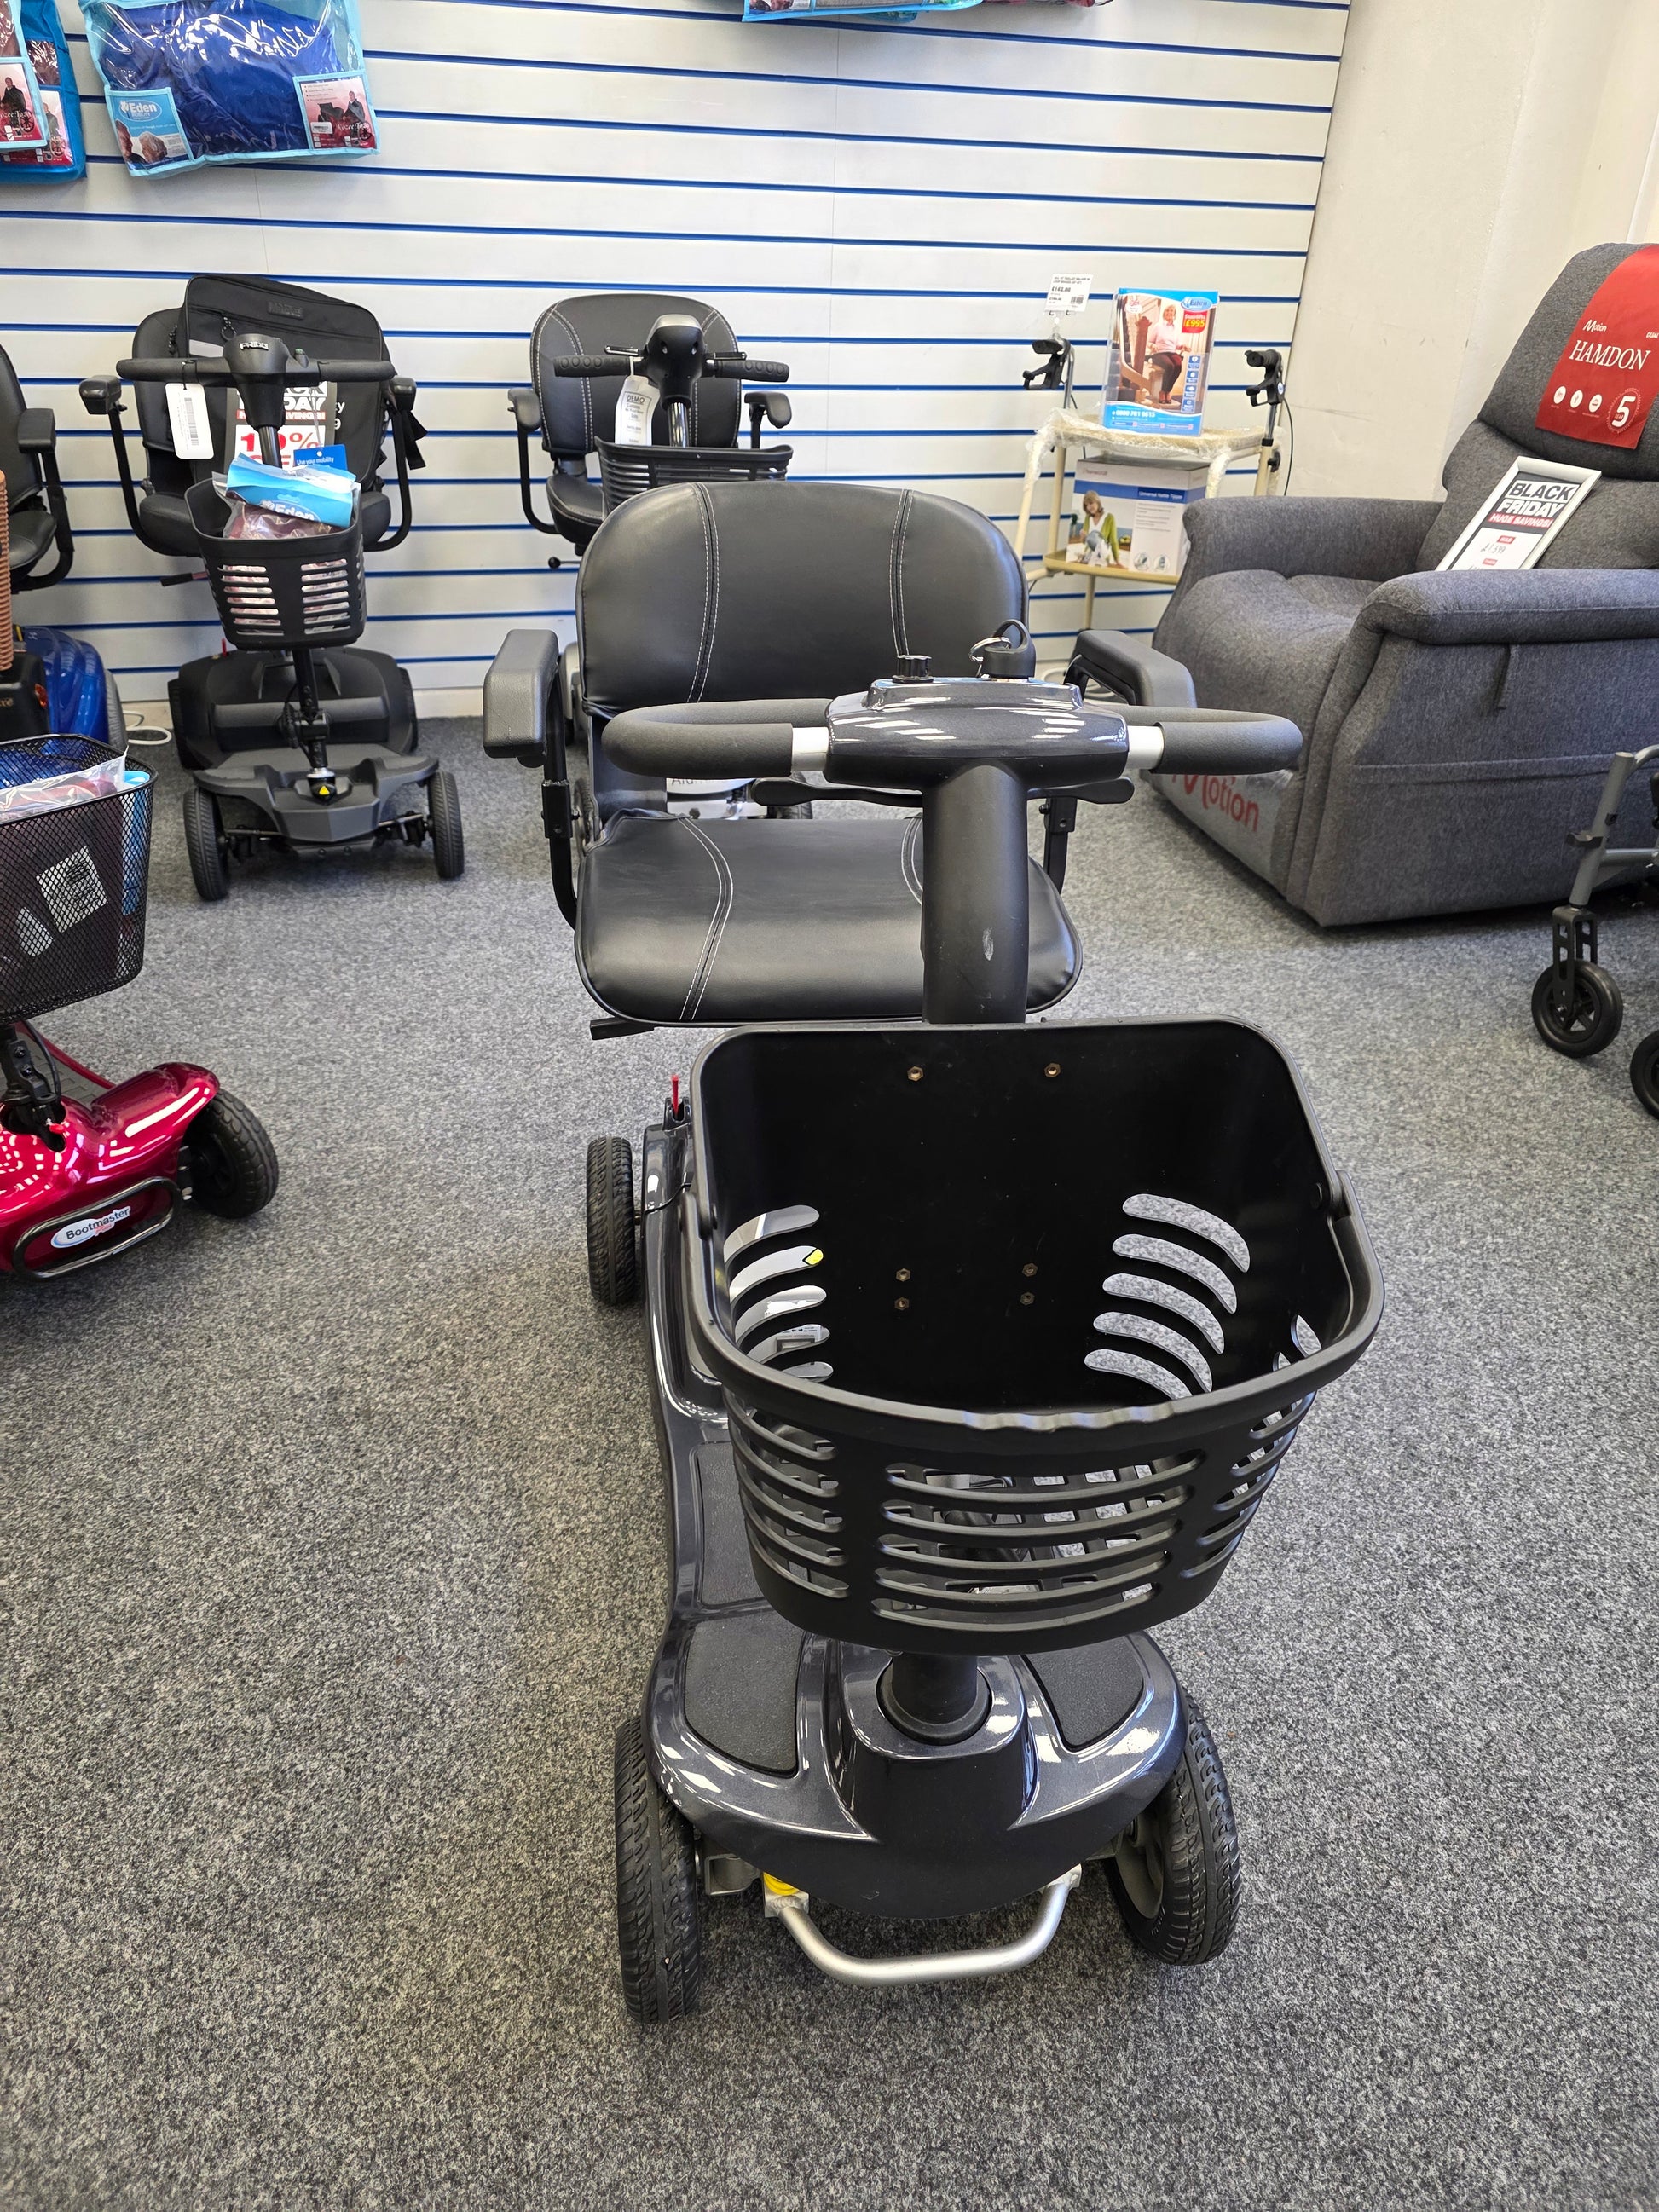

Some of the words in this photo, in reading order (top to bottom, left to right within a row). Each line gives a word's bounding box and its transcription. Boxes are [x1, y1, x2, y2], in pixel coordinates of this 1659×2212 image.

[130, 101, 157, 113] Eden
[1184, 319, 1206, 327] £995
[1582, 319, 1607, 332] Motion
[1569, 339, 1652, 371] HAMDON
[627, 394, 645, 405] DEMO
[1611, 395, 1637, 428] 5
[315, 456, 334, 465] mobility
[1509, 482, 1576, 501] BLACK
[1495, 498, 1566, 518] FRIDAY
[1488, 513, 1515, 524] HUGE
[1512, 517, 1554, 528] SAVINGS!
[66, 1207, 130, 1240] Bootmaster
